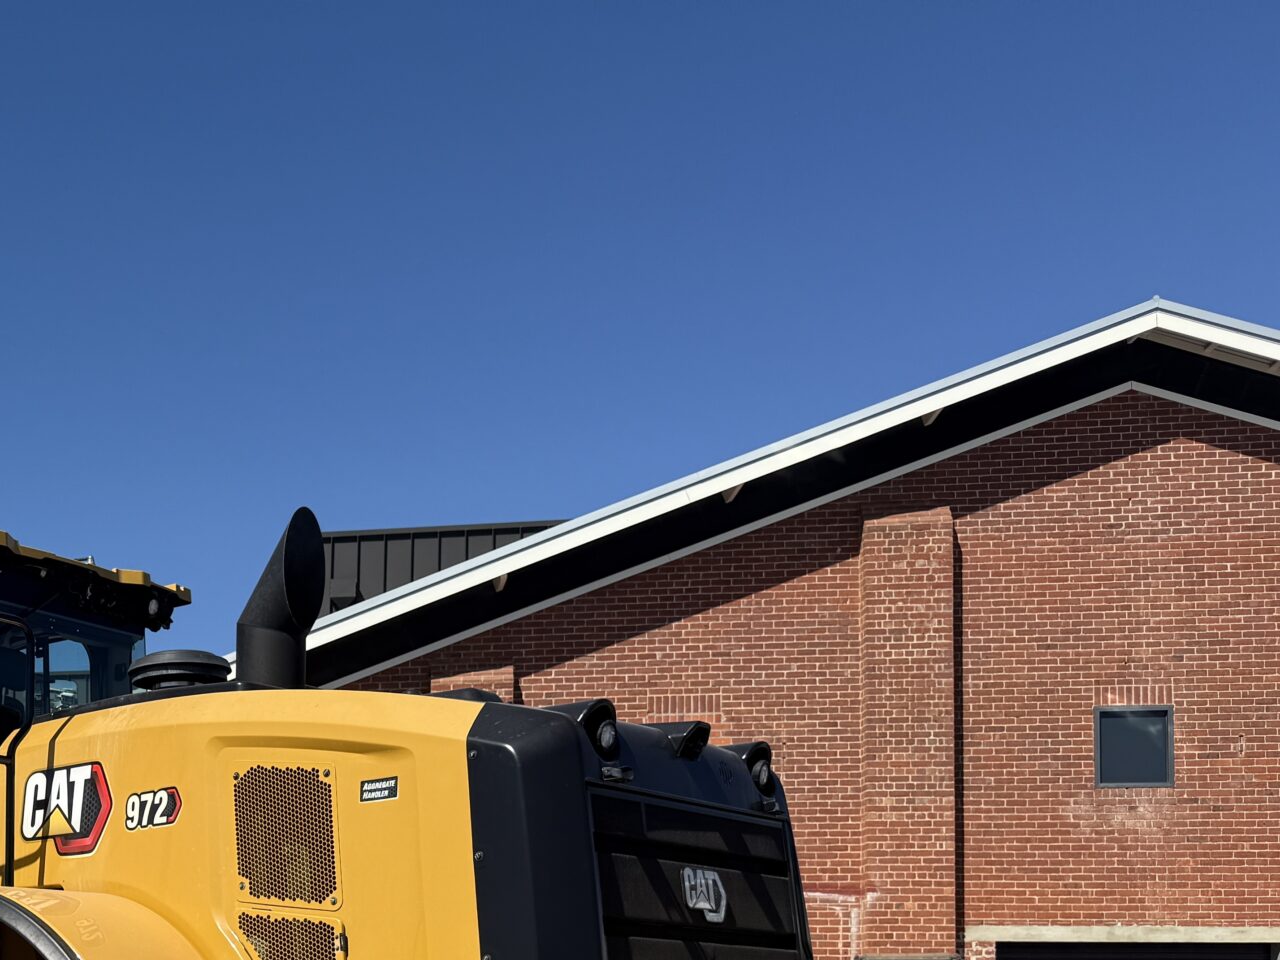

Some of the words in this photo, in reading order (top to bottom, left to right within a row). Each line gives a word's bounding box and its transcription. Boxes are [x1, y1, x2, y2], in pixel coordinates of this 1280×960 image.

[22, 764, 92, 839] CAT
[363, 780, 396, 790] AGGREGATE
[363, 790, 389, 799] HANDLER
[126, 790, 168, 830] 972
[683, 867, 716, 910] CAT
